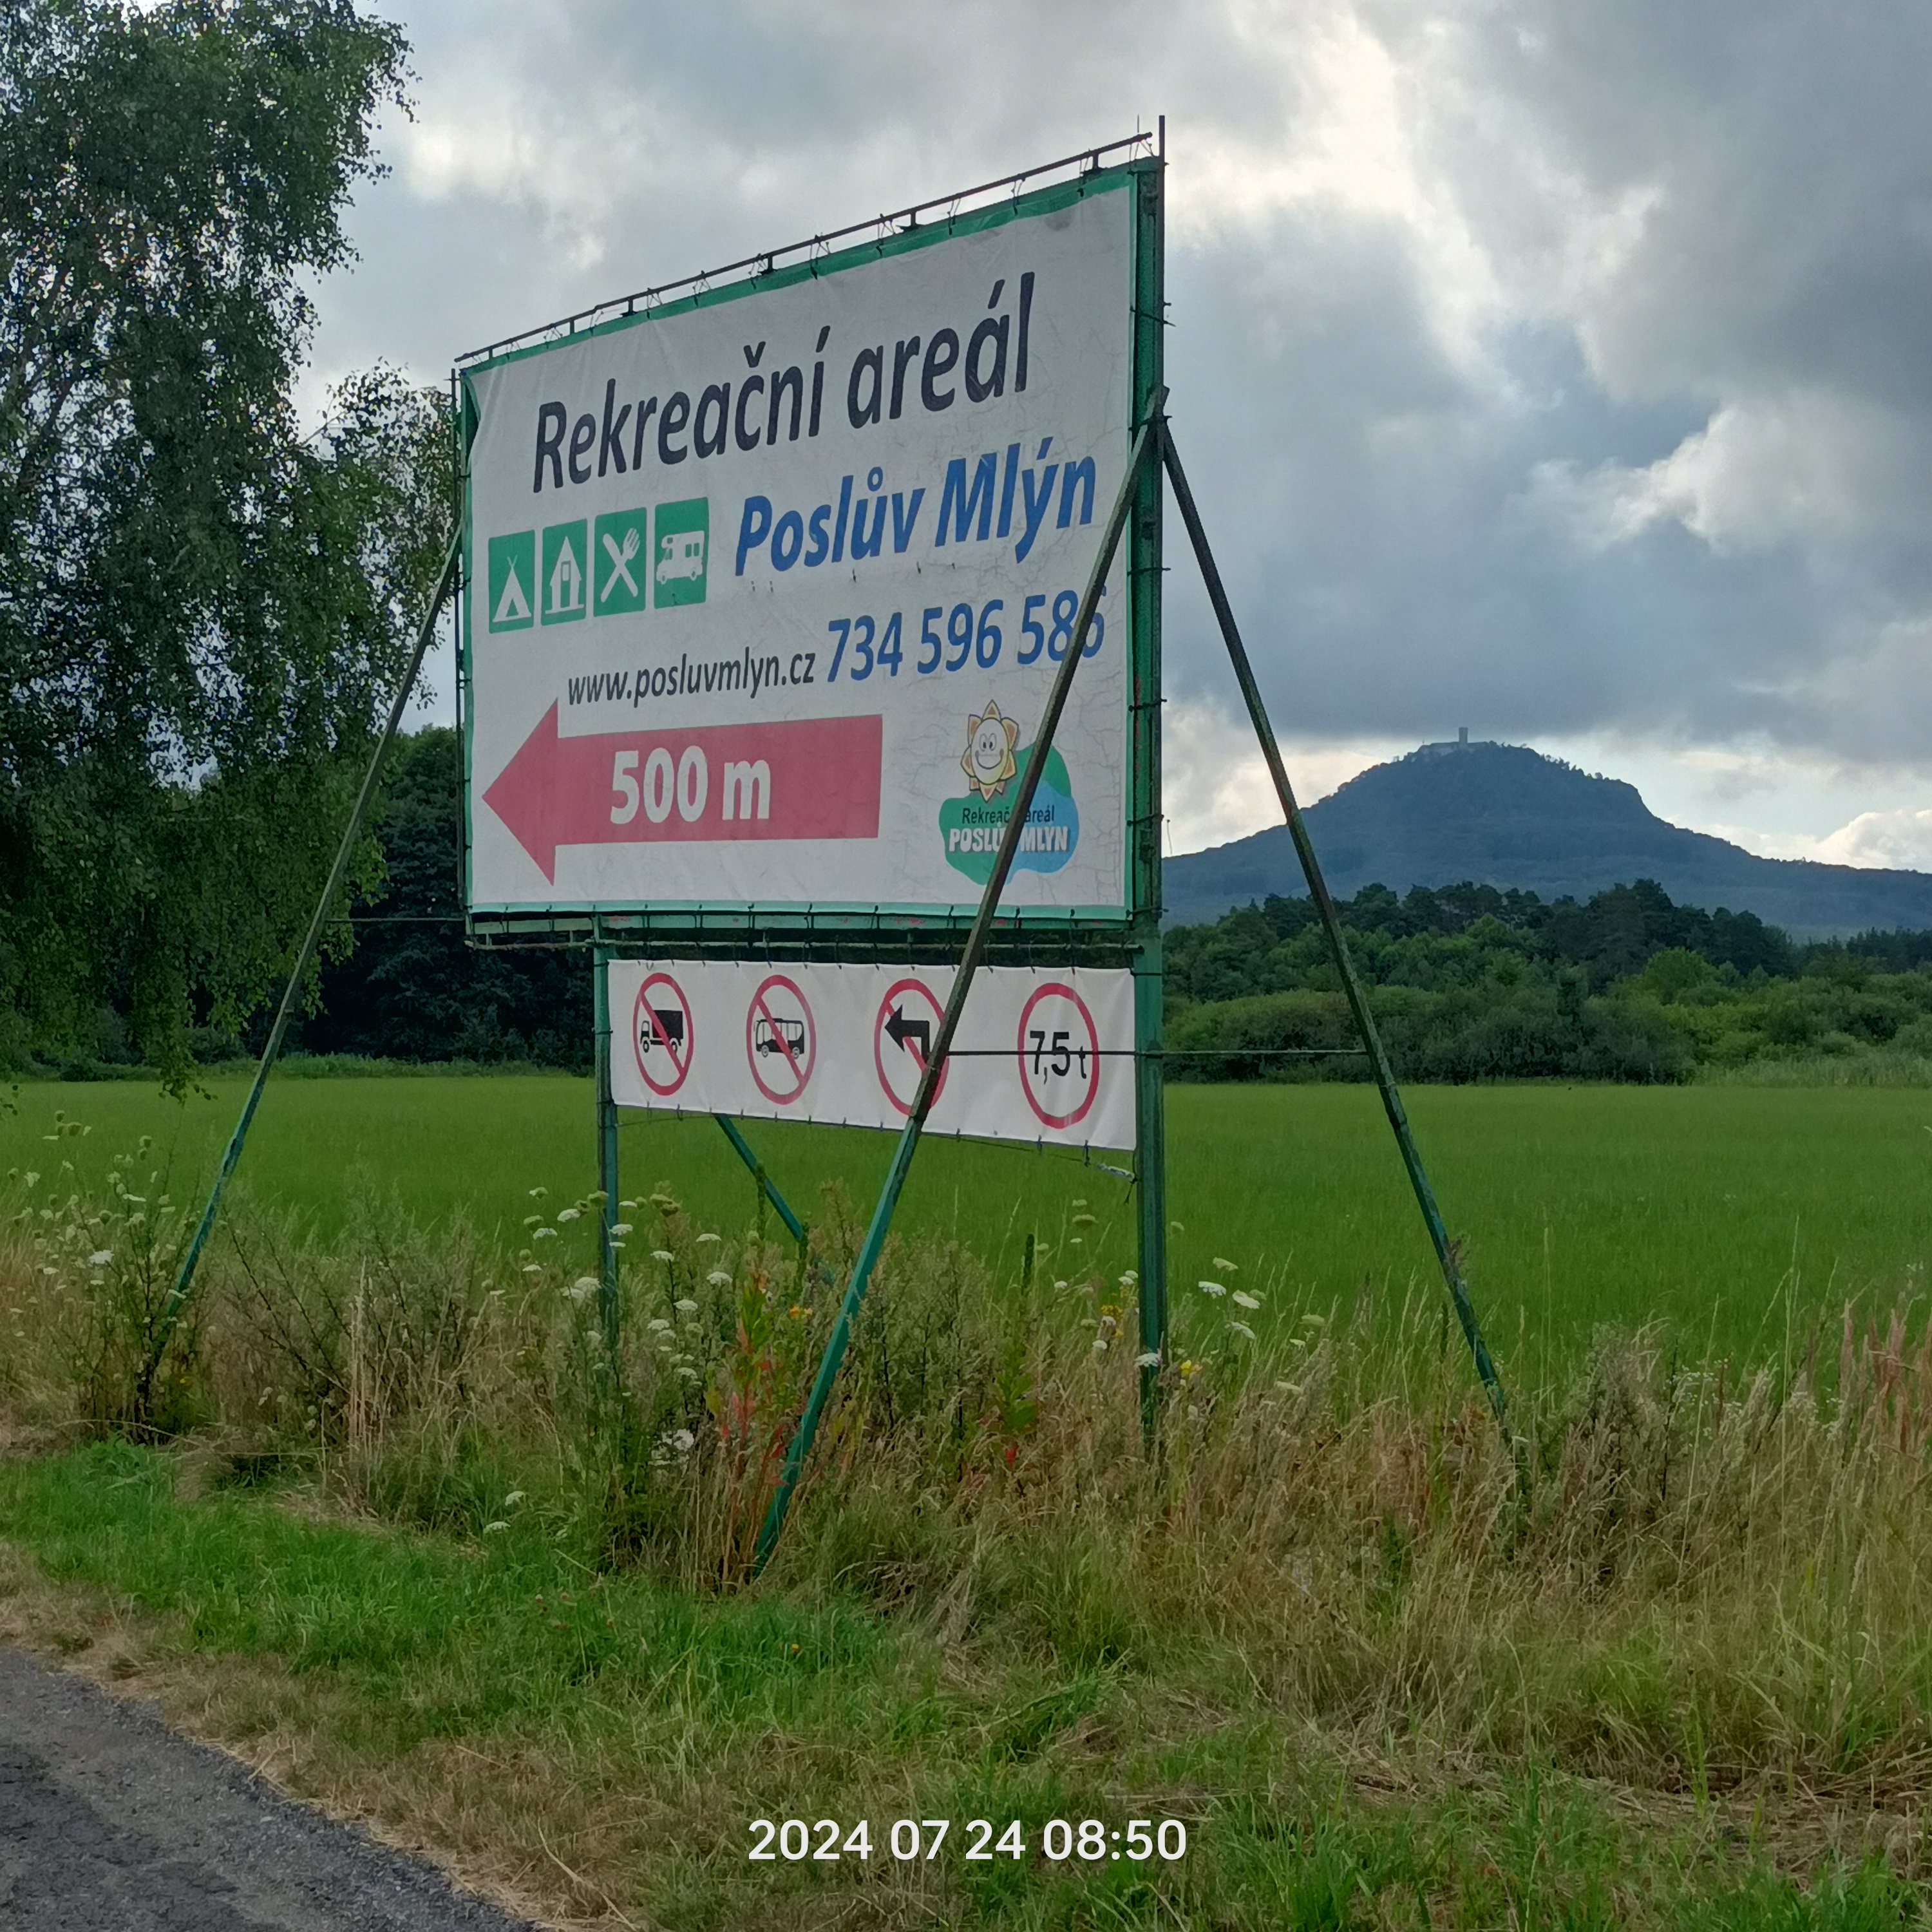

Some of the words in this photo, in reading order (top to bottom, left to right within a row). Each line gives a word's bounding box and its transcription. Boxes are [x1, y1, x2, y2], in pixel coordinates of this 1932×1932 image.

[533, 325, 831, 493] Rekreační
[847, 271, 1036, 430] areál
[734, 466, 925, 577] Poslův
[934, 436, 1097, 563] Mlýn
[568, 646, 816, 708] www.posluvmlyn.cz
[827, 612, 903, 683] 734
[917, 599, 1004, 674] 596
[610, 745, 708, 824] 500
[722, 760, 771, 820] m
[961, 806, 1010, 824] Rekreač
[949, 821, 1007, 853] POSLŮ
